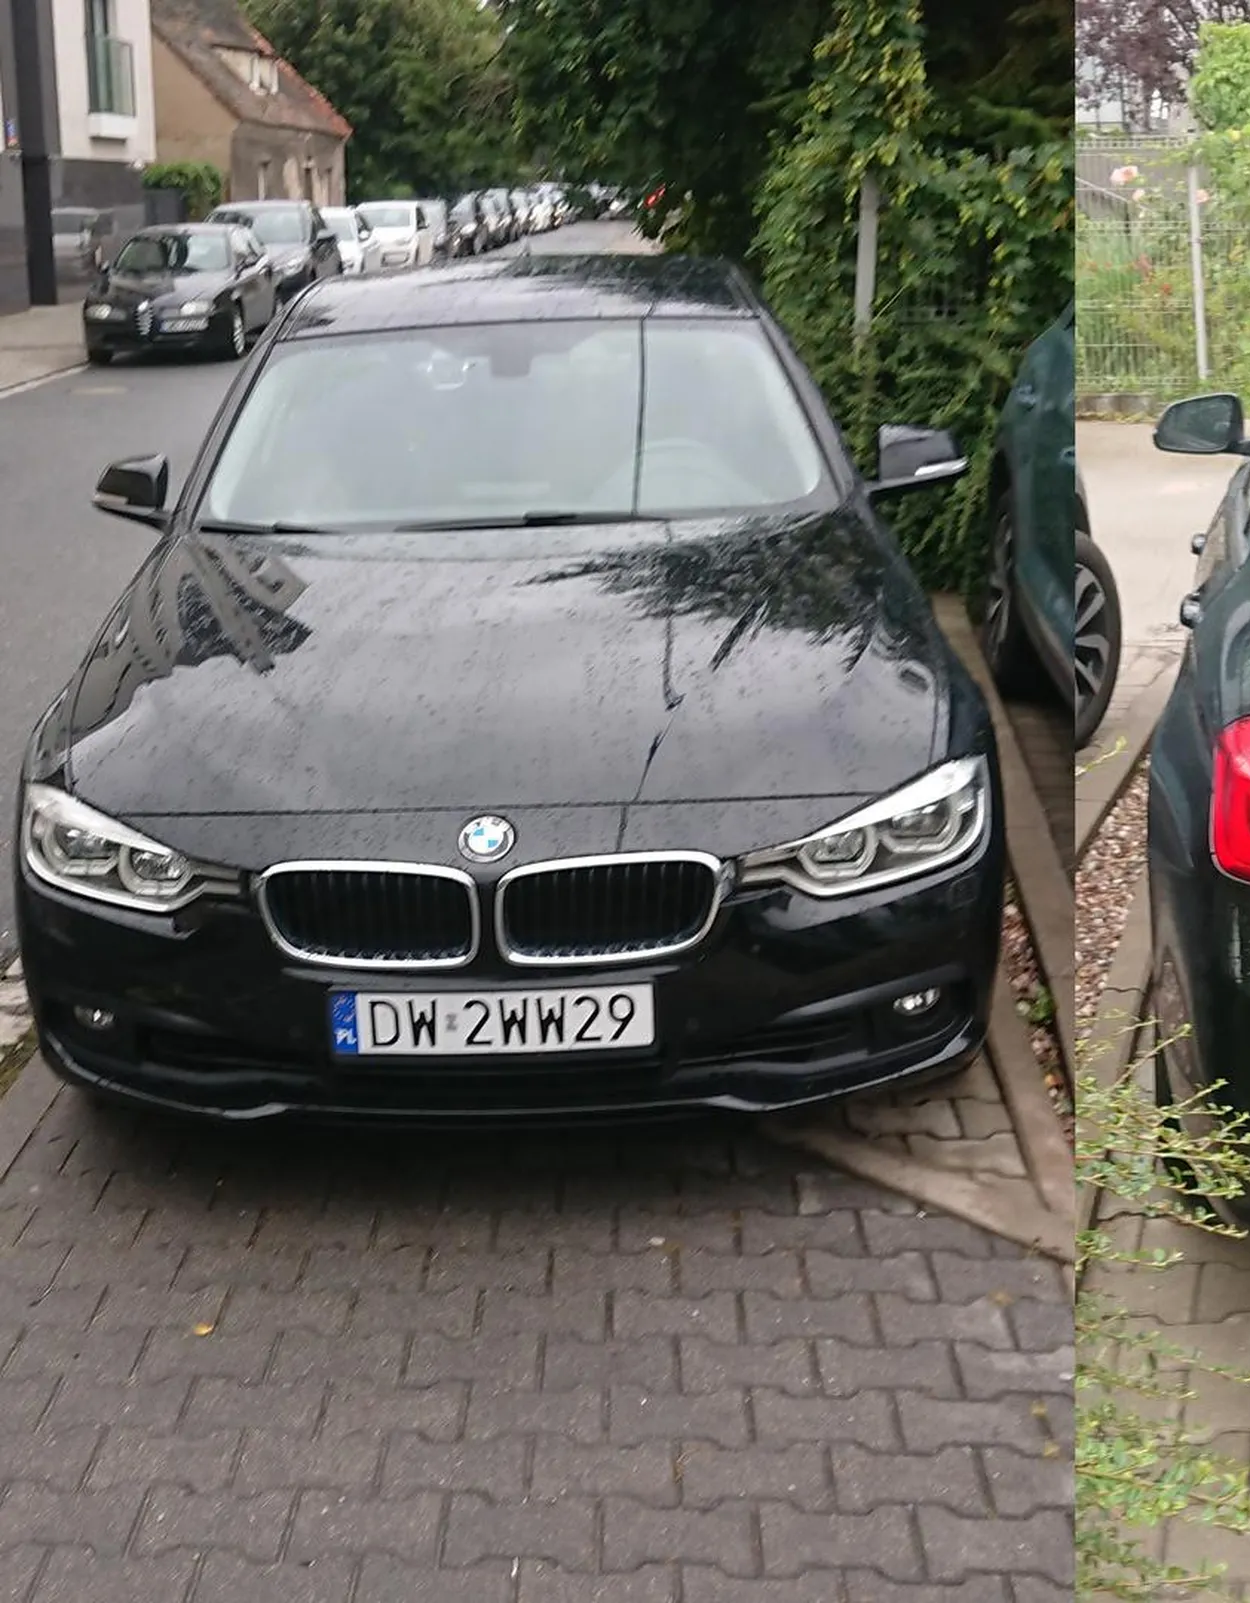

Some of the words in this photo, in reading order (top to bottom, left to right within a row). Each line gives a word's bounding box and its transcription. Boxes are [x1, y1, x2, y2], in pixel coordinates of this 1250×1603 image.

[335, 1028, 357, 1045] PL
[368, 999, 437, 1047] DW
[463, 994, 637, 1047] 2WW29
